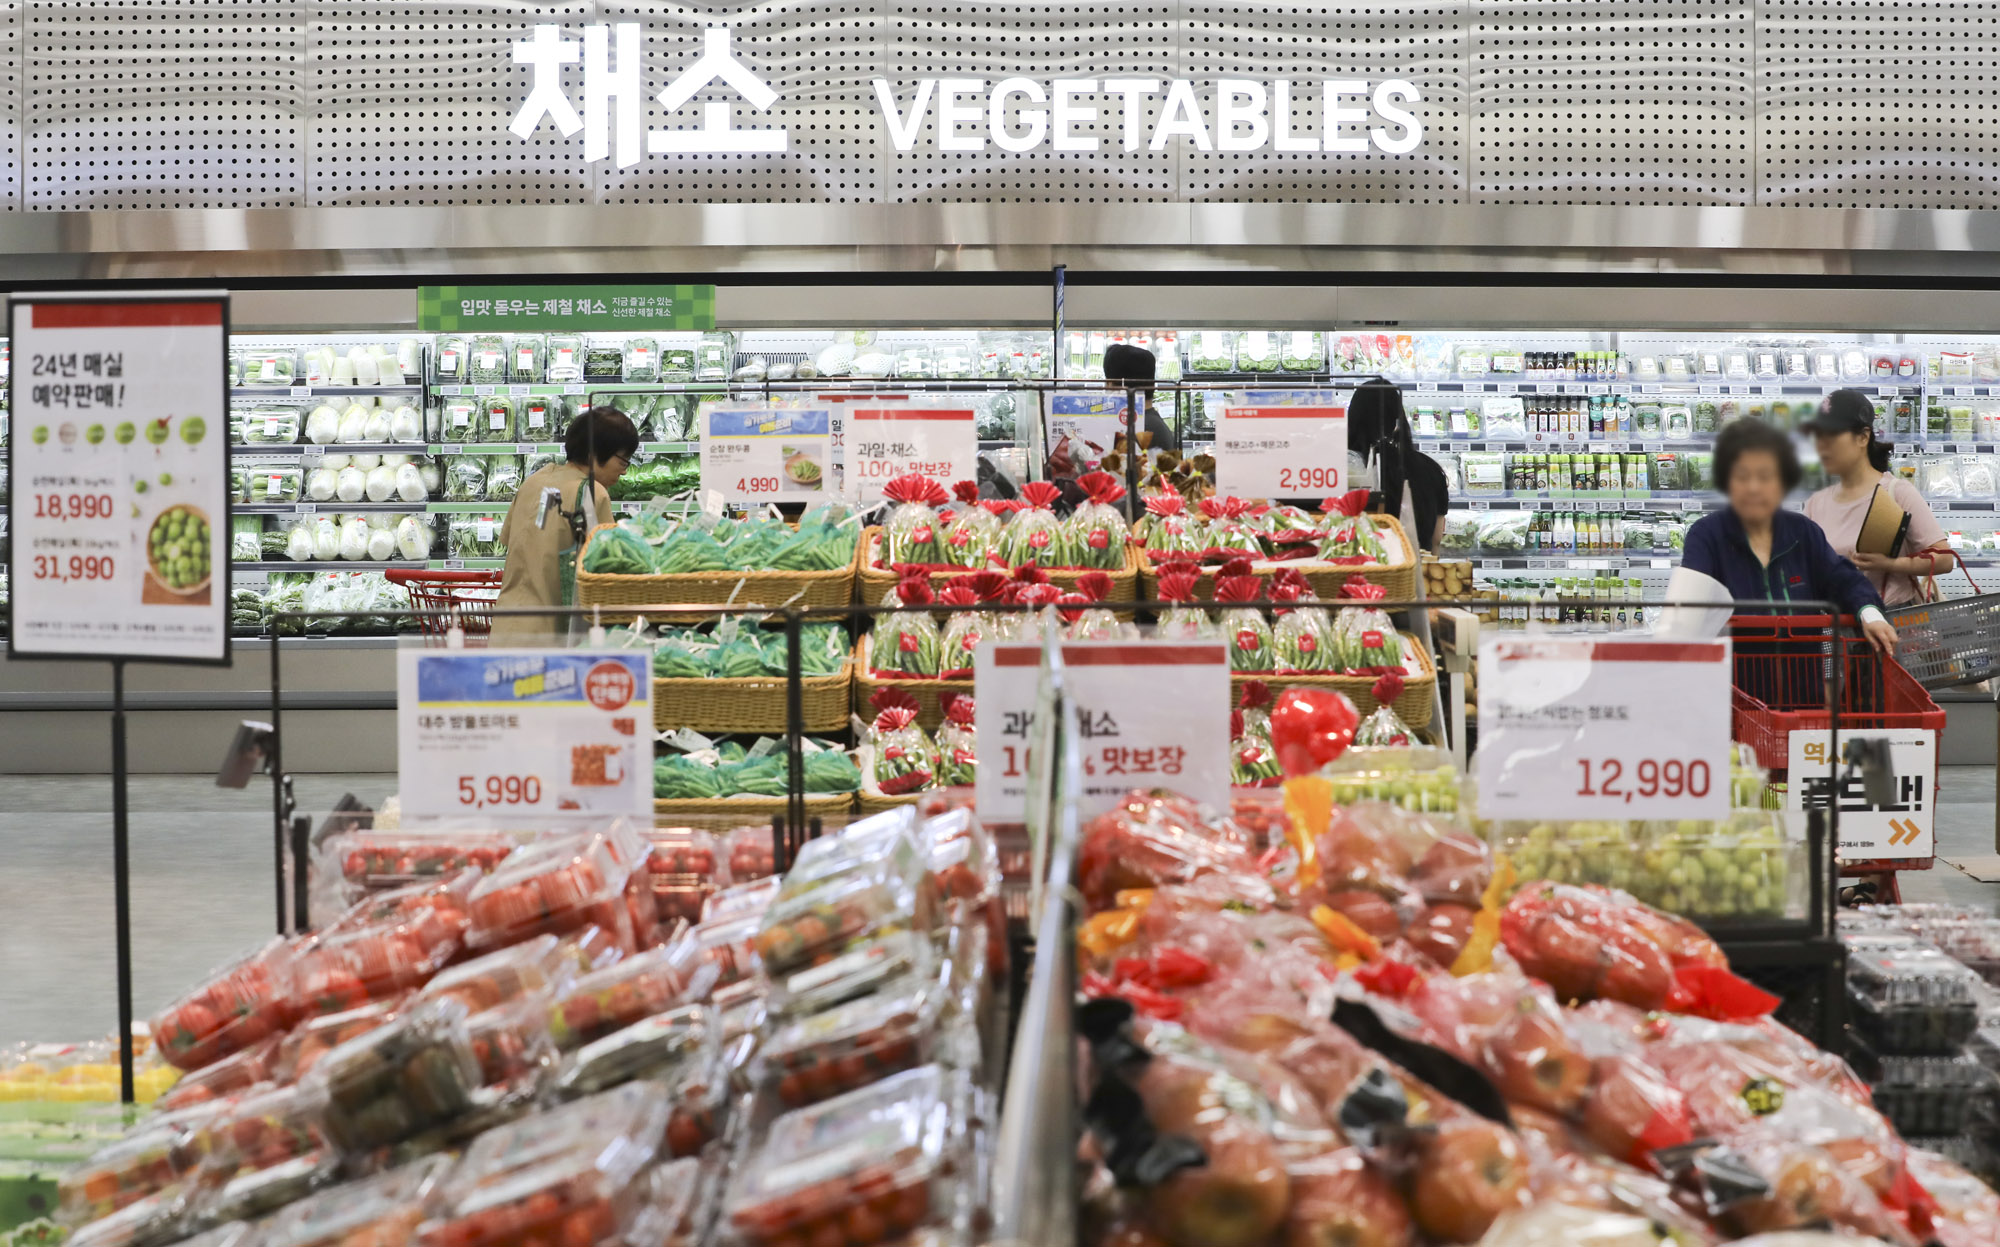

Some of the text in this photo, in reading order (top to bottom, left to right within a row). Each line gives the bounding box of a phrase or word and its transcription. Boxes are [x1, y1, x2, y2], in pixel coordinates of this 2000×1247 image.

[508, 22, 1424, 168] 채소 VEGETABLES
[460, 299, 607, 316] 입맛 돋우는 제철 채소
[611, 307, 672, 317] 신선한 제철 채소
[612, 296, 673, 307] 지금 즐길 수 있는
[32, 352, 123, 378] 24년 매실
[32, 384, 125, 408] 예약판매!
[858, 442, 919, 458] 과일·채소
[857, 461, 952, 478] 100% 맛보장
[1279, 467, 1339, 492] 2,990
[736, 477, 779, 495] 4,990
[34, 494, 113, 522] 18,990
[33, 556, 115, 583] 31,990
[418, 714, 520, 729] 대추 방울토마토
[1002, 708, 1120, 739] 과채소
[1102, 746, 1187, 776] 맛보장
[458, 775, 542, 810] 5,990
[1576, 759, 1711, 803] 12,990
